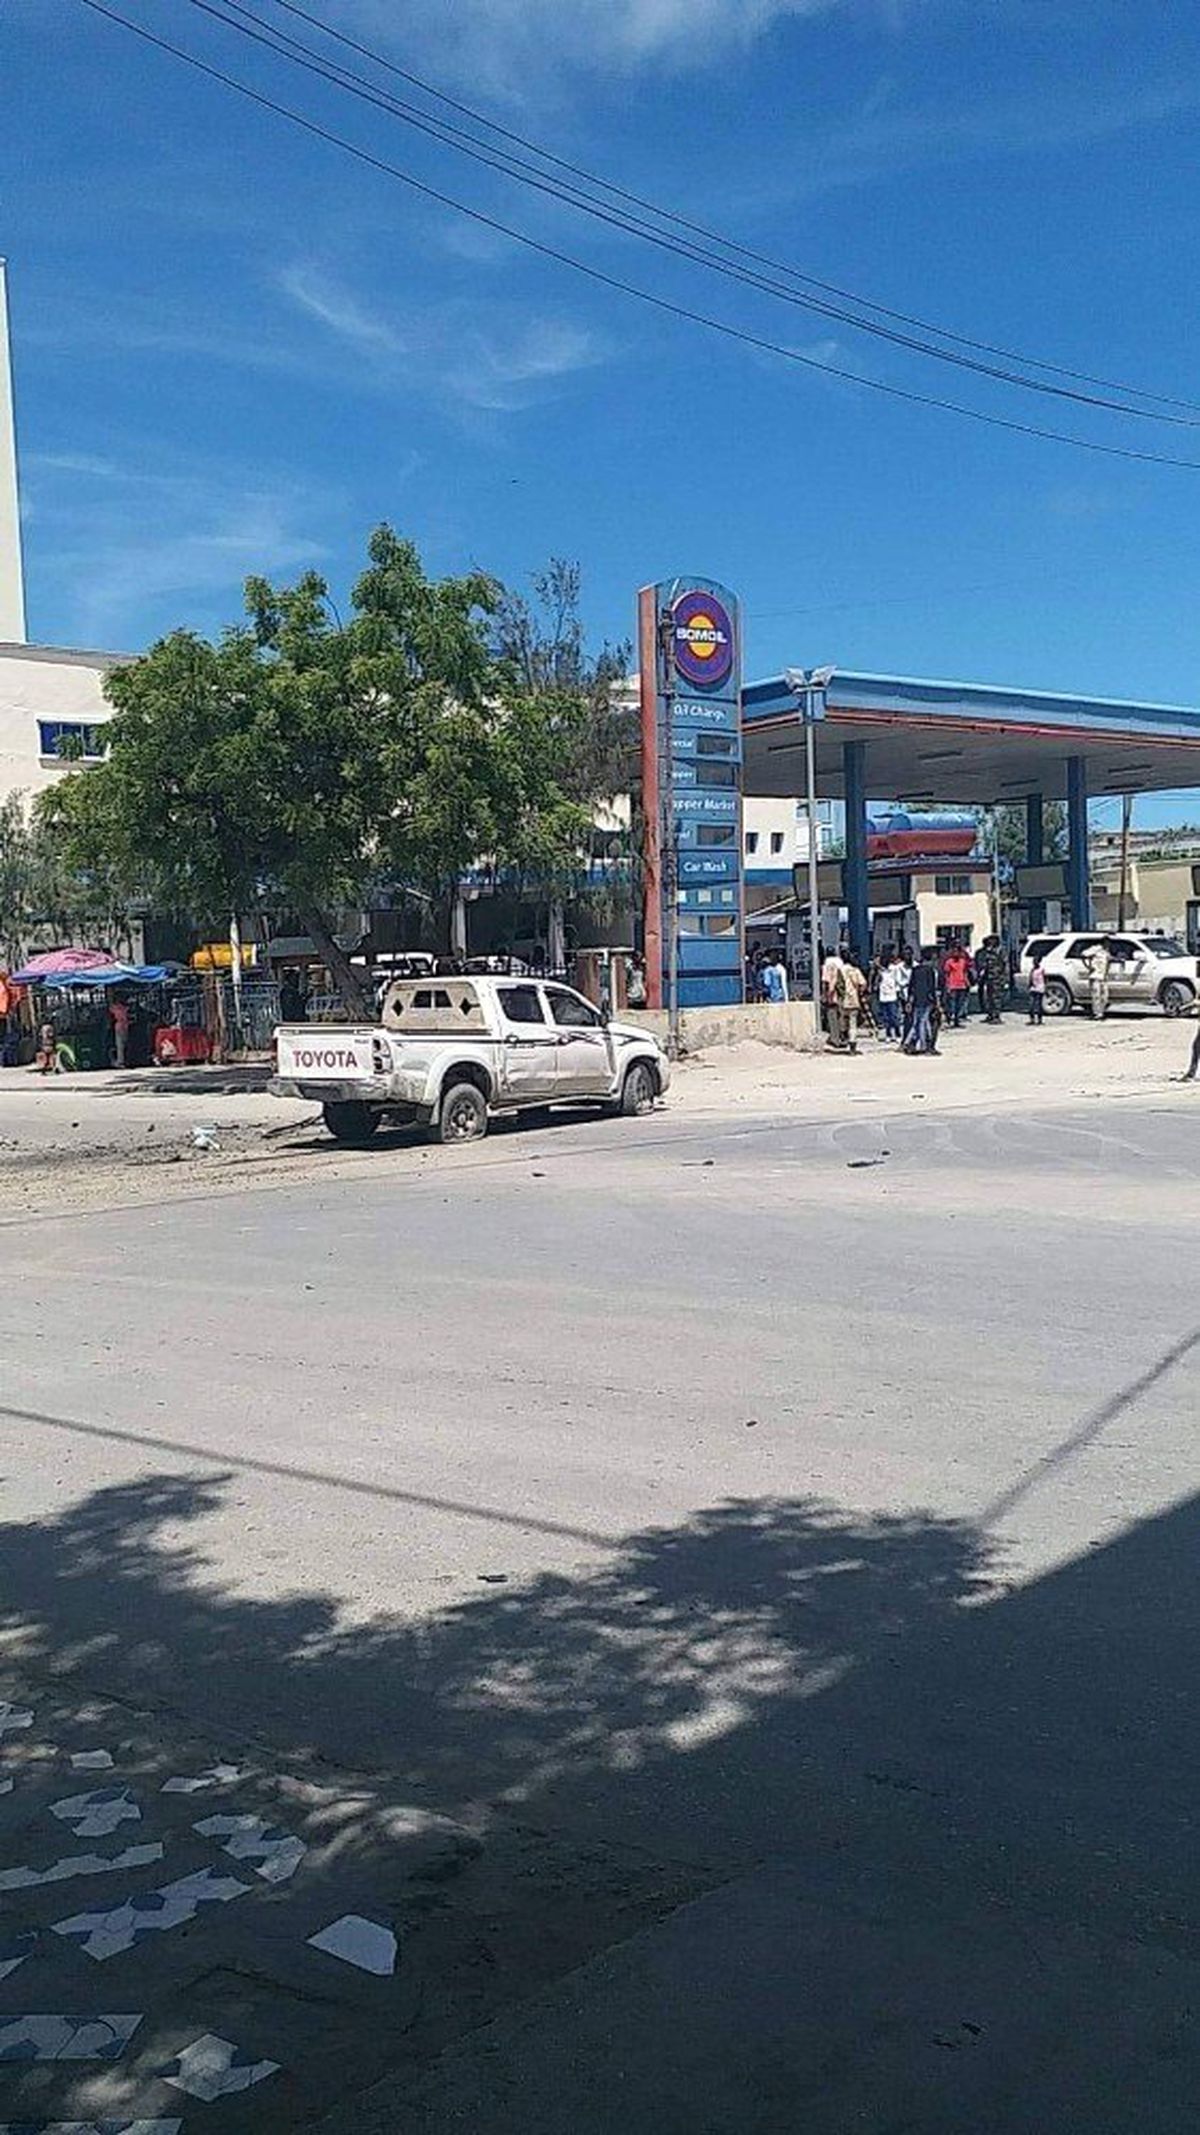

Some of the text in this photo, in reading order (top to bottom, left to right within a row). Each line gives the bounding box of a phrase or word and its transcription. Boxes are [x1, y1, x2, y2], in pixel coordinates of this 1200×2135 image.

[683, 860, 727, 872] Car Wash
[292, 1050, 358, 1068] TOYOTA
